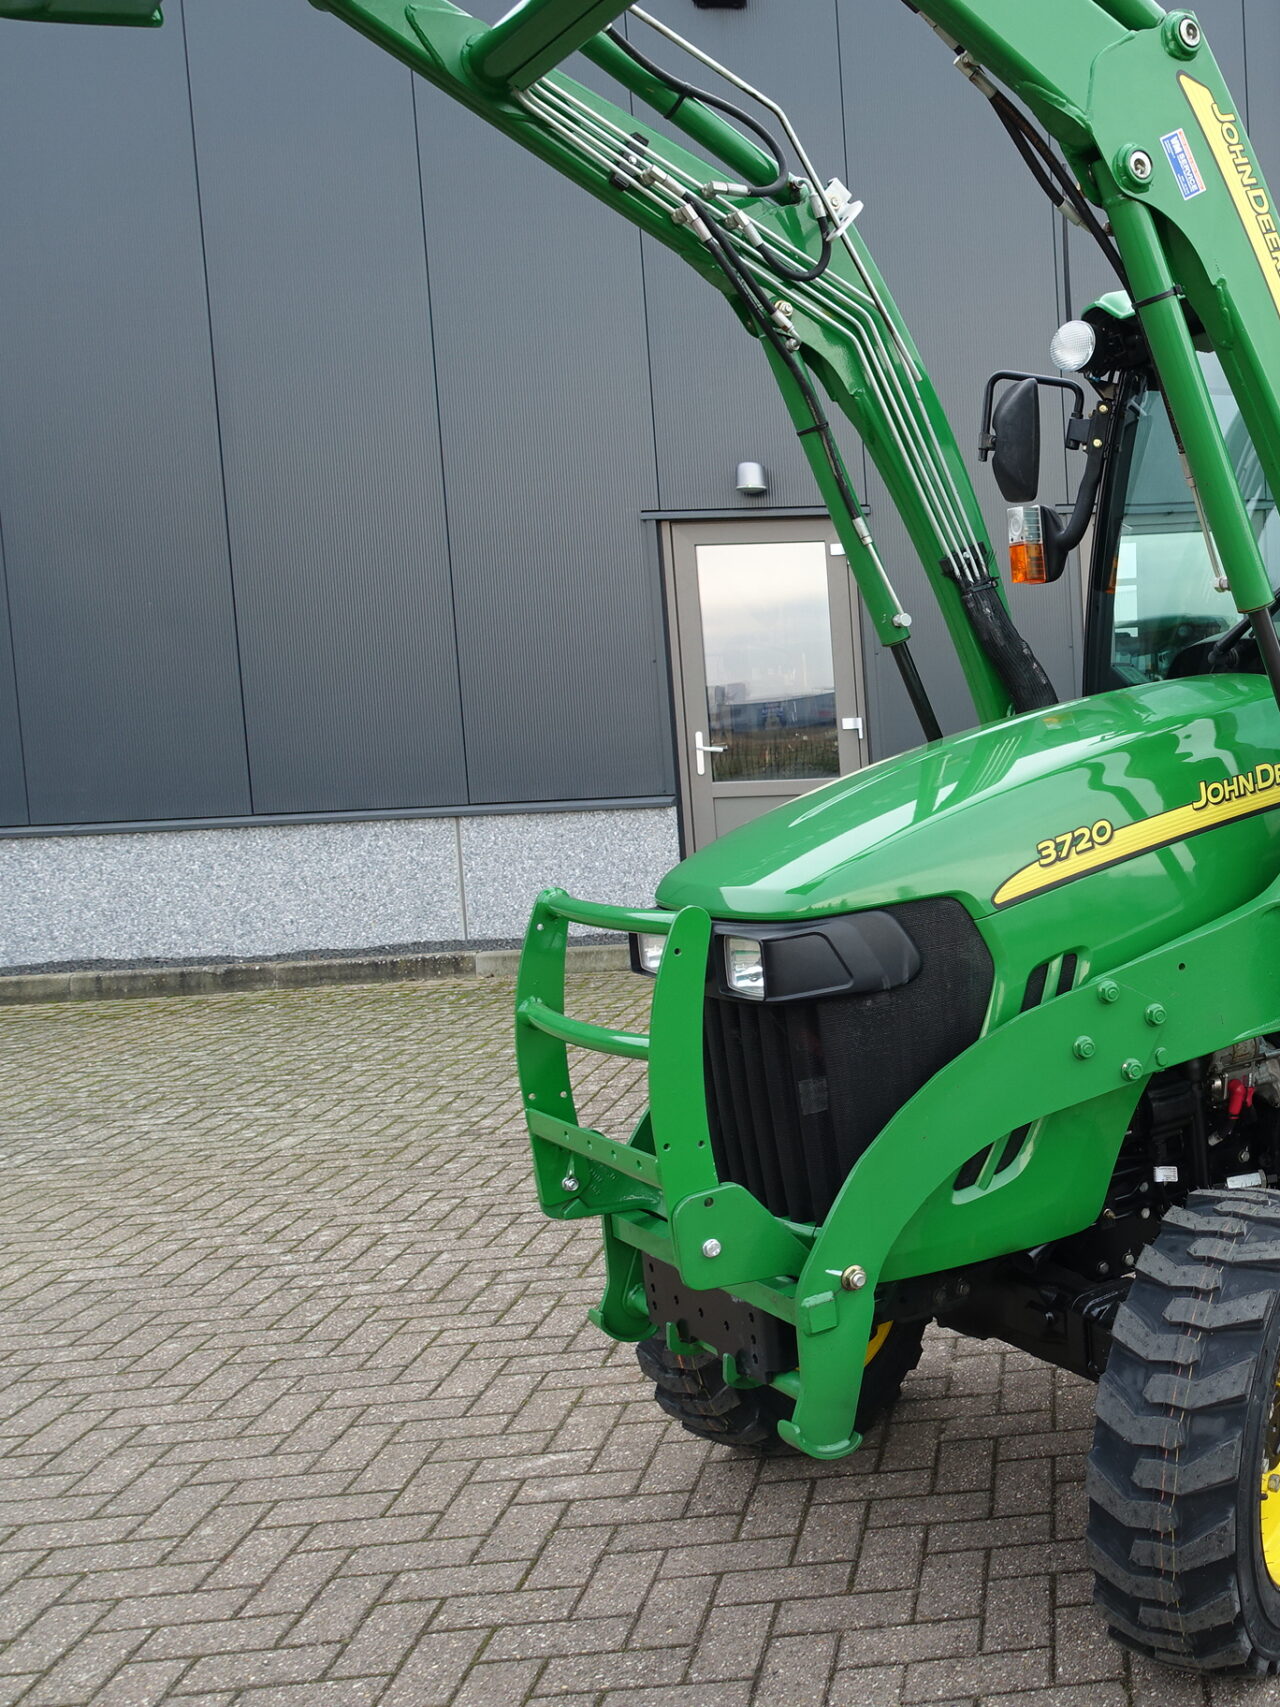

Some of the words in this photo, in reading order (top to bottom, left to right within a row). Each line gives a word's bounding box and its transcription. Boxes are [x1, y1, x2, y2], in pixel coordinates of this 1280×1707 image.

[1211, 102, 1257, 188] JOHN
[1192, 771, 1255, 811] JOHN
[1036, 819, 1115, 867] 3720
